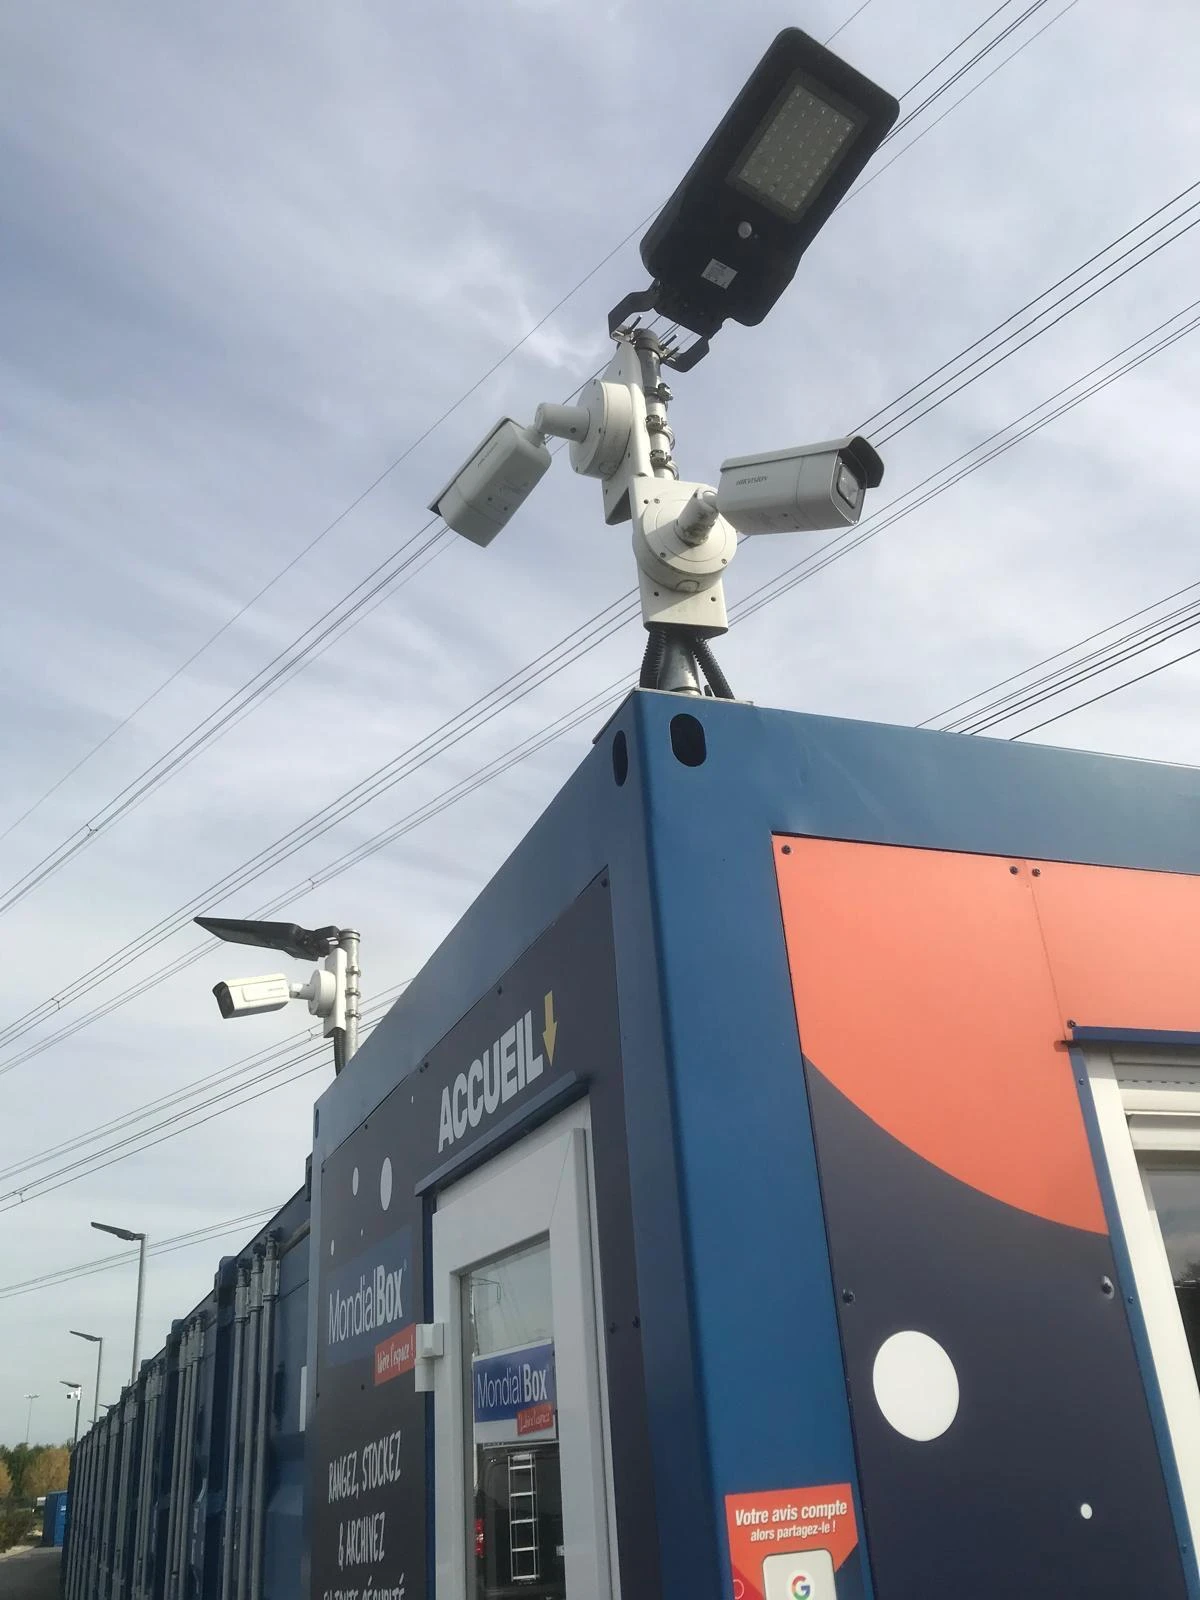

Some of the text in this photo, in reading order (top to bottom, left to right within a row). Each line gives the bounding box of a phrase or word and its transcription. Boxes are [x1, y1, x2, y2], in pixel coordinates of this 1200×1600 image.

[438, 1010, 543, 1153] ACCUEIL
[328, 1265, 403, 1345] MondialBox
[328, 1430, 401, 1504] RANGEZ, STOCKEZ
[338, 1512, 385, 1572] & ARCHIVEZ
[735, 1500, 847, 1526] Votre avis compte
[750, 1529, 774, 1542] alors
[777, 1521, 830, 1541] partagez-le
